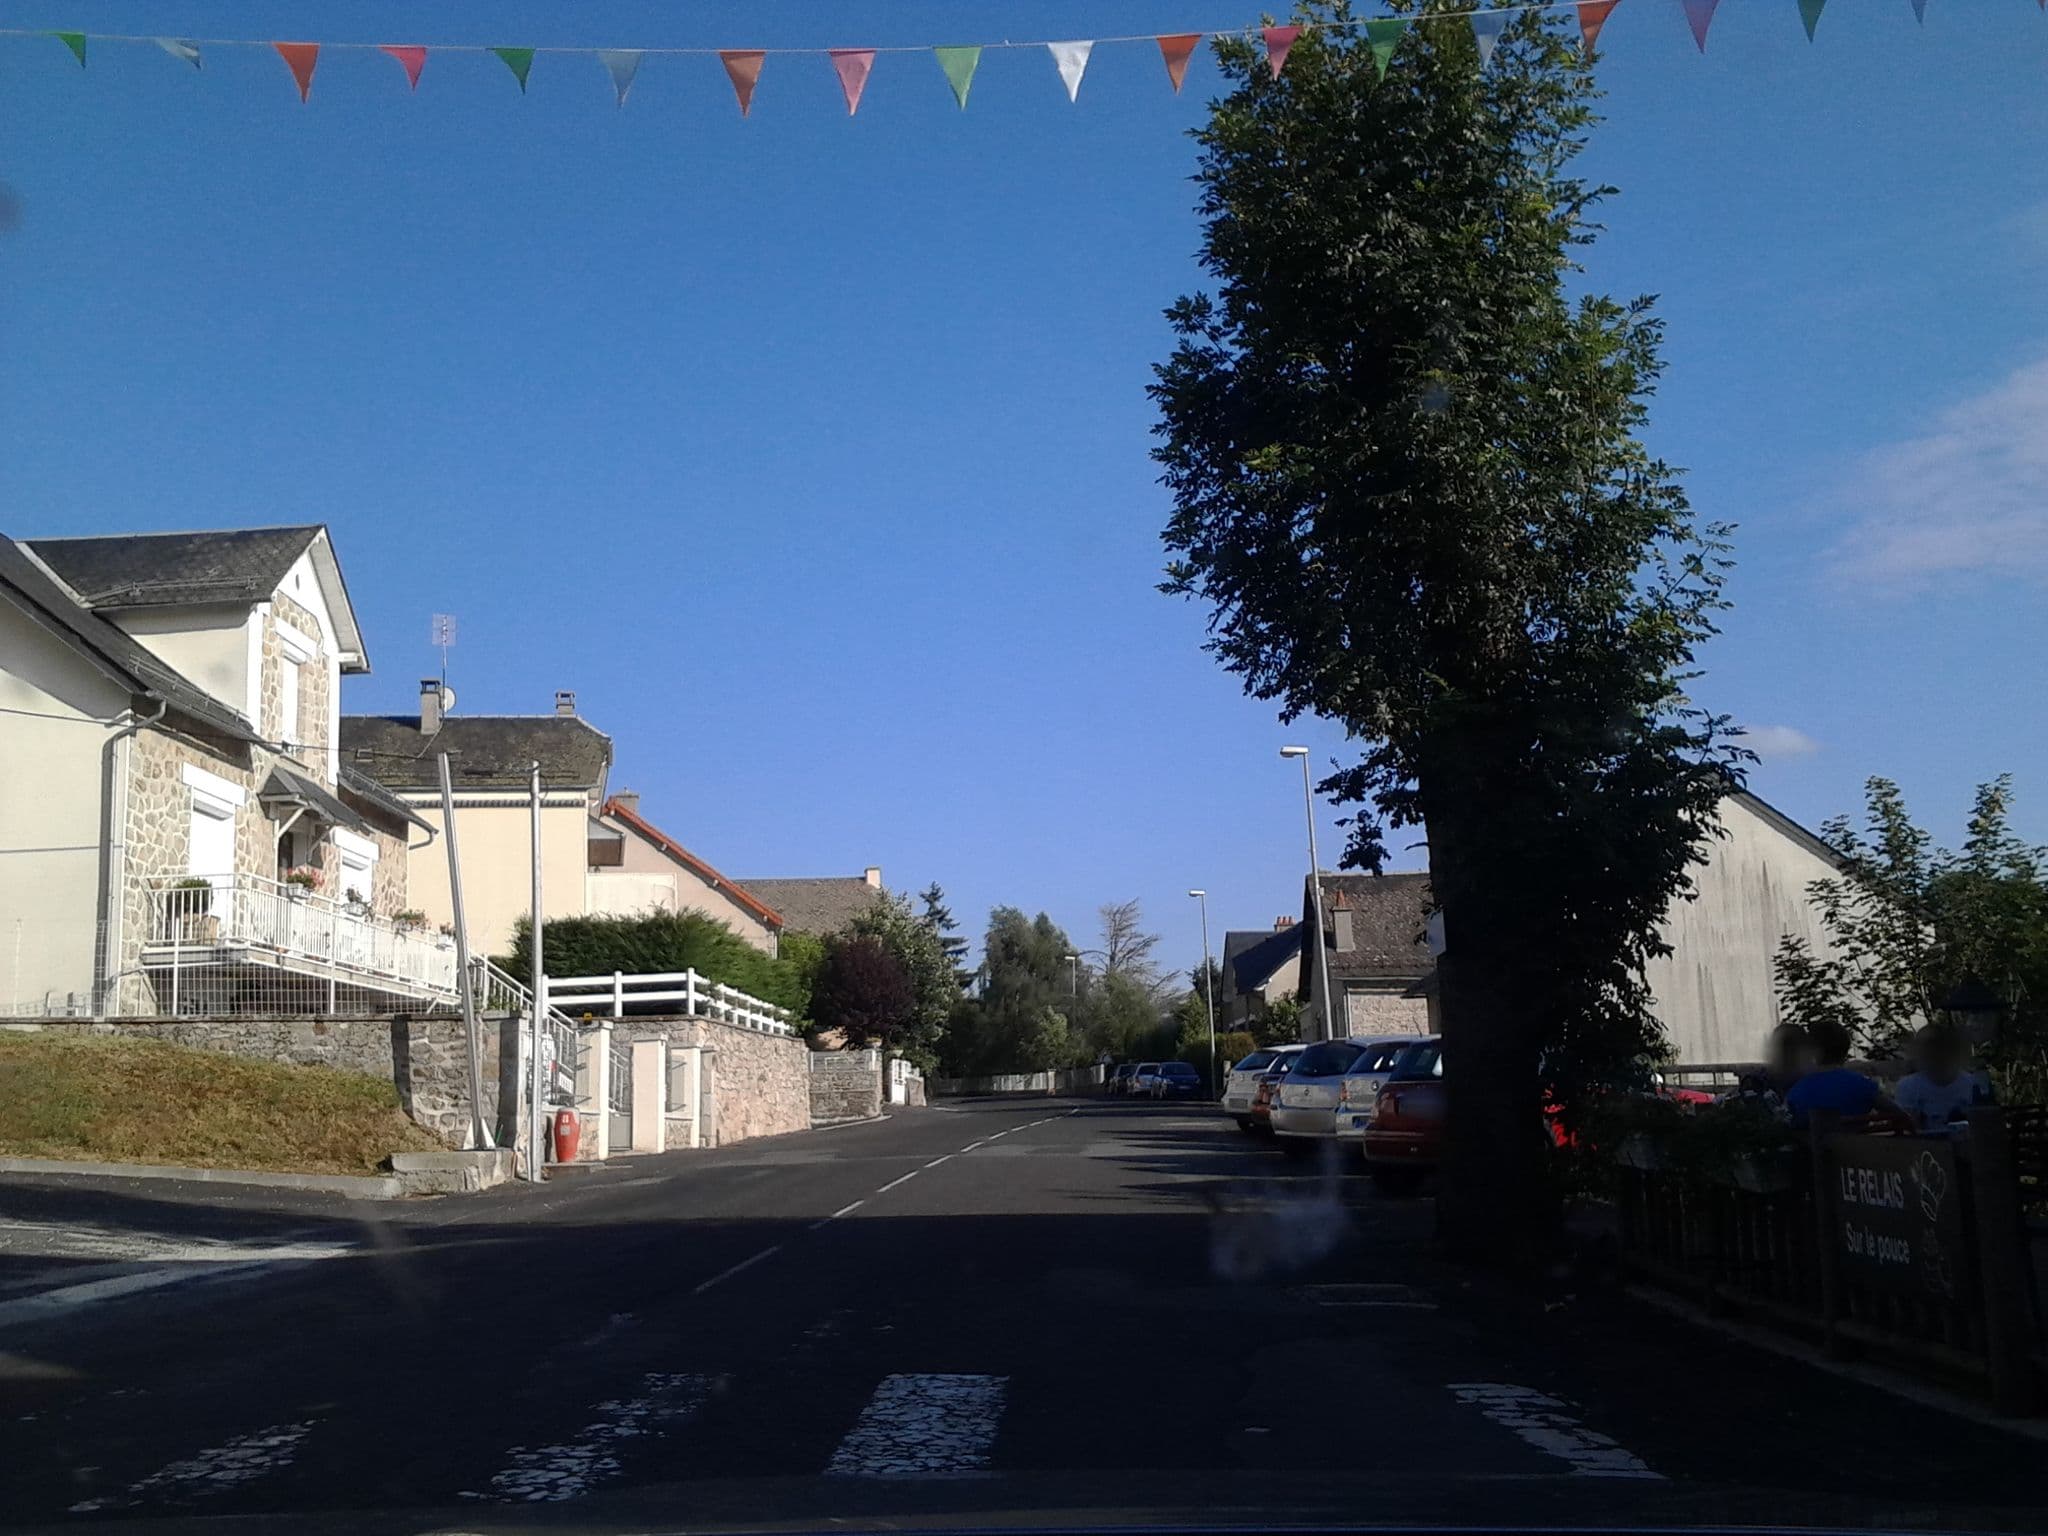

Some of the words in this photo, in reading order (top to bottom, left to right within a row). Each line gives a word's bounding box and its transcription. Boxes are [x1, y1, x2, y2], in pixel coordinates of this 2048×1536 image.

[1841, 1167, 1857, 1202] LE
[1858, 1168, 1904, 1208] RELAIS
[1846, 1222, 1863, 1253] Sur
[1864, 1225, 1875, 1257] le
[1877, 1235, 1910, 1264] pouce
